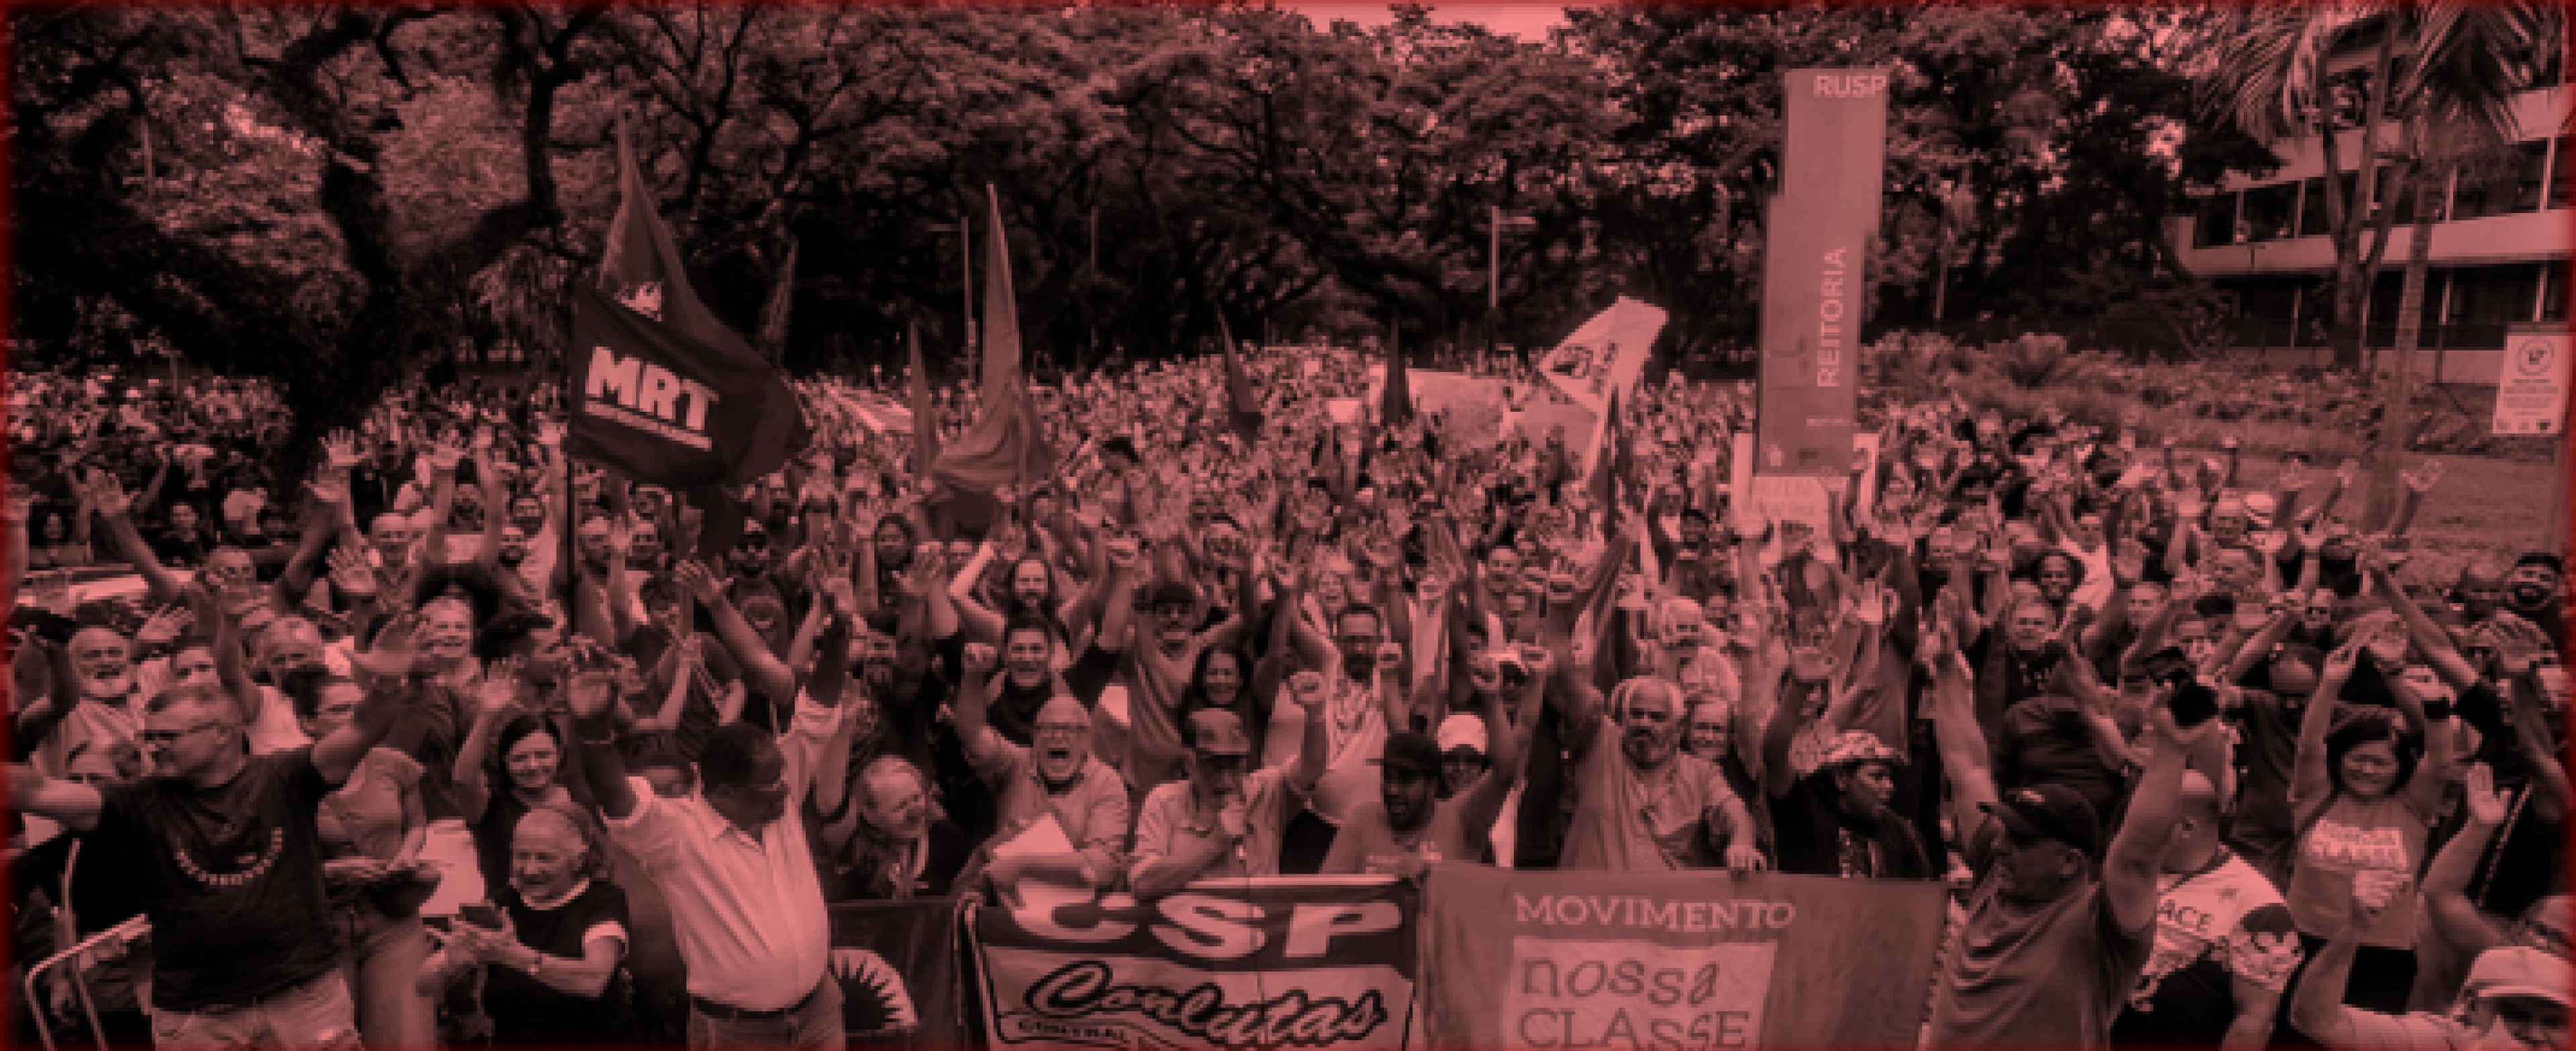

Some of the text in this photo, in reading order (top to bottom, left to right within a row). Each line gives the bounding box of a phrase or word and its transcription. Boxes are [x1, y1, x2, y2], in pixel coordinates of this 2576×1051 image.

[1813, 73, 1886, 99] RUSP
[1817, 246, 1847, 388] REITORIA
[584, 345, 720, 431] MRT
[1013, 880, 1403, 958] CSP
[1513, 892, 1797, 932] MOVIMENTO
[1024, 960, 1387, 1046] Conlutas
[1517, 1007, 1750, 1051] CLASSE
